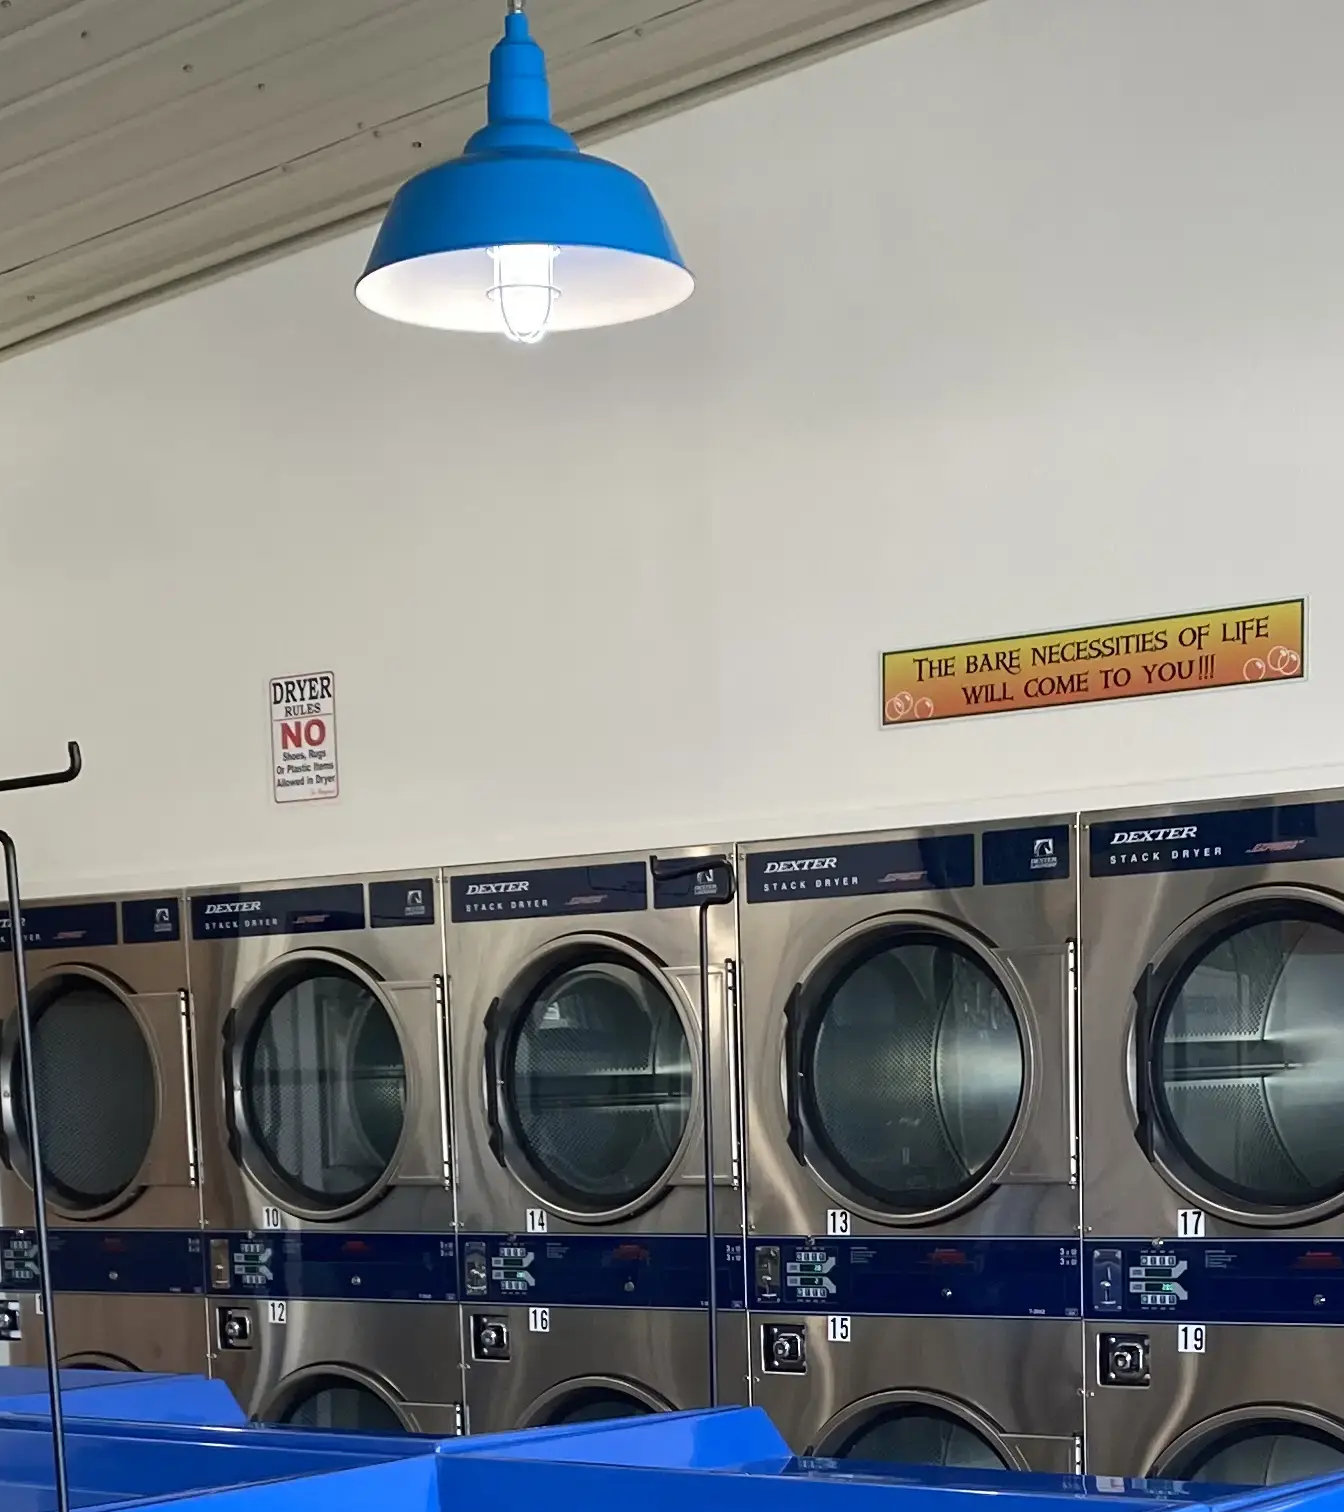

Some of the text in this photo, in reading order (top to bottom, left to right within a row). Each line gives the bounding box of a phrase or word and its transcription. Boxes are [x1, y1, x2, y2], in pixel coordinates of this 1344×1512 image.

[913, 616, 1270, 682] THE BARE NECESSITIES OF LIFE
[961, 654, 1216, 705] WILL COME TO YOU!!!
[272, 676, 332, 704] DRYER
[284, 702, 321, 717] RULES
[280, 719, 326, 749] NO
[1110, 826, 1198, 845] DEXTER
[764, 857, 837, 874] DEXTER
[1110, 847, 1222, 864] STACK DRYER
[466, 881, 529, 895] DEXTER
[763, 877, 859, 892] STACK DRYER
[205, 901, 261, 914] DEXTER
[466, 899, 548, 912] STACK DRYER
[265, 1209, 279, 1227] 10
[529, 1210, 545, 1231] 14
[830, 1212, 849, 1234] 13
[1181, 1212, 1203, 1234] 17
[270, 1303, 285, 1322] 12
[531, 1309, 548, 1330] 16
[831, 1317, 849, 1340] 15
[1182, 1328, 1203, 1350] 19
